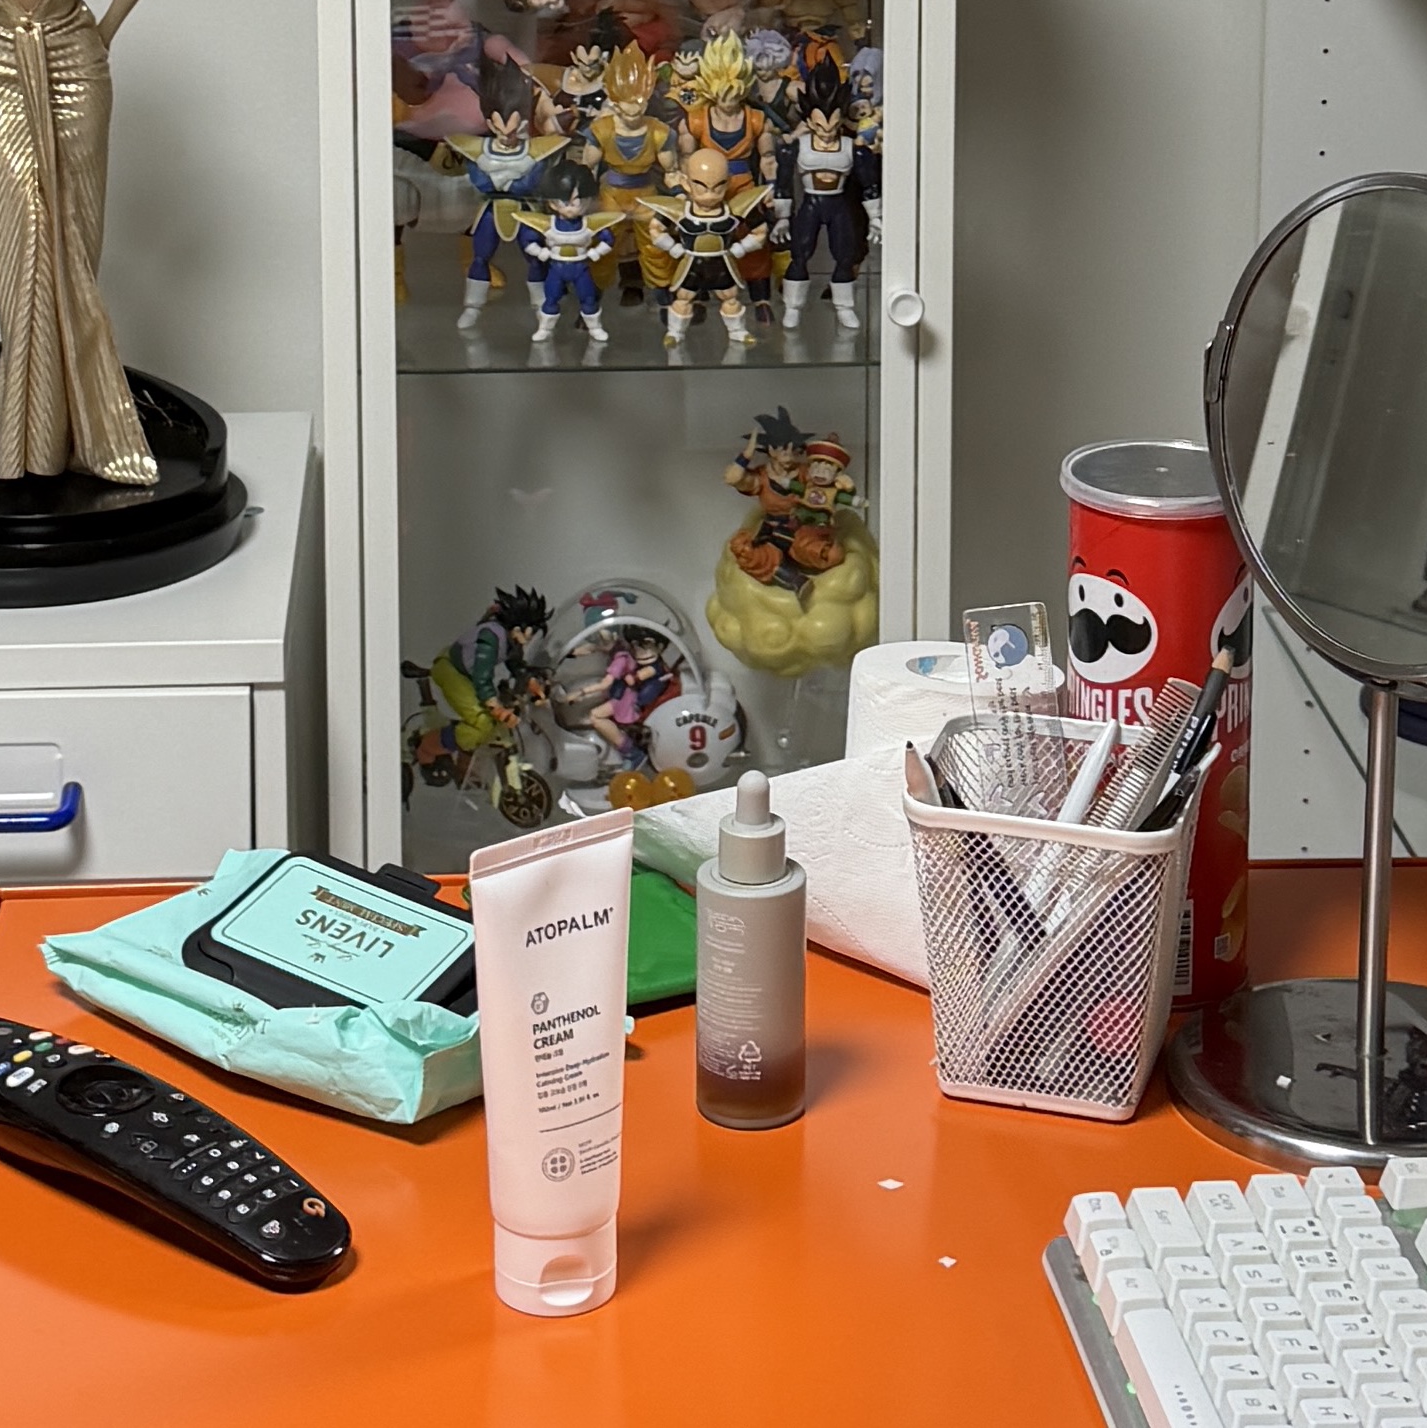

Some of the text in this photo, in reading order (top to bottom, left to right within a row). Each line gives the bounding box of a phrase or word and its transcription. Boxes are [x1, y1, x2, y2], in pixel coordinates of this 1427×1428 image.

[689, 725, 706, 751] 9
[295, 909, 395, 958] LIVENS
[526, 908, 610, 948] ATOPALM
[533, 1005, 601, 1036] PANTHENOL
[533, 1028, 574, 1050] CREAM
